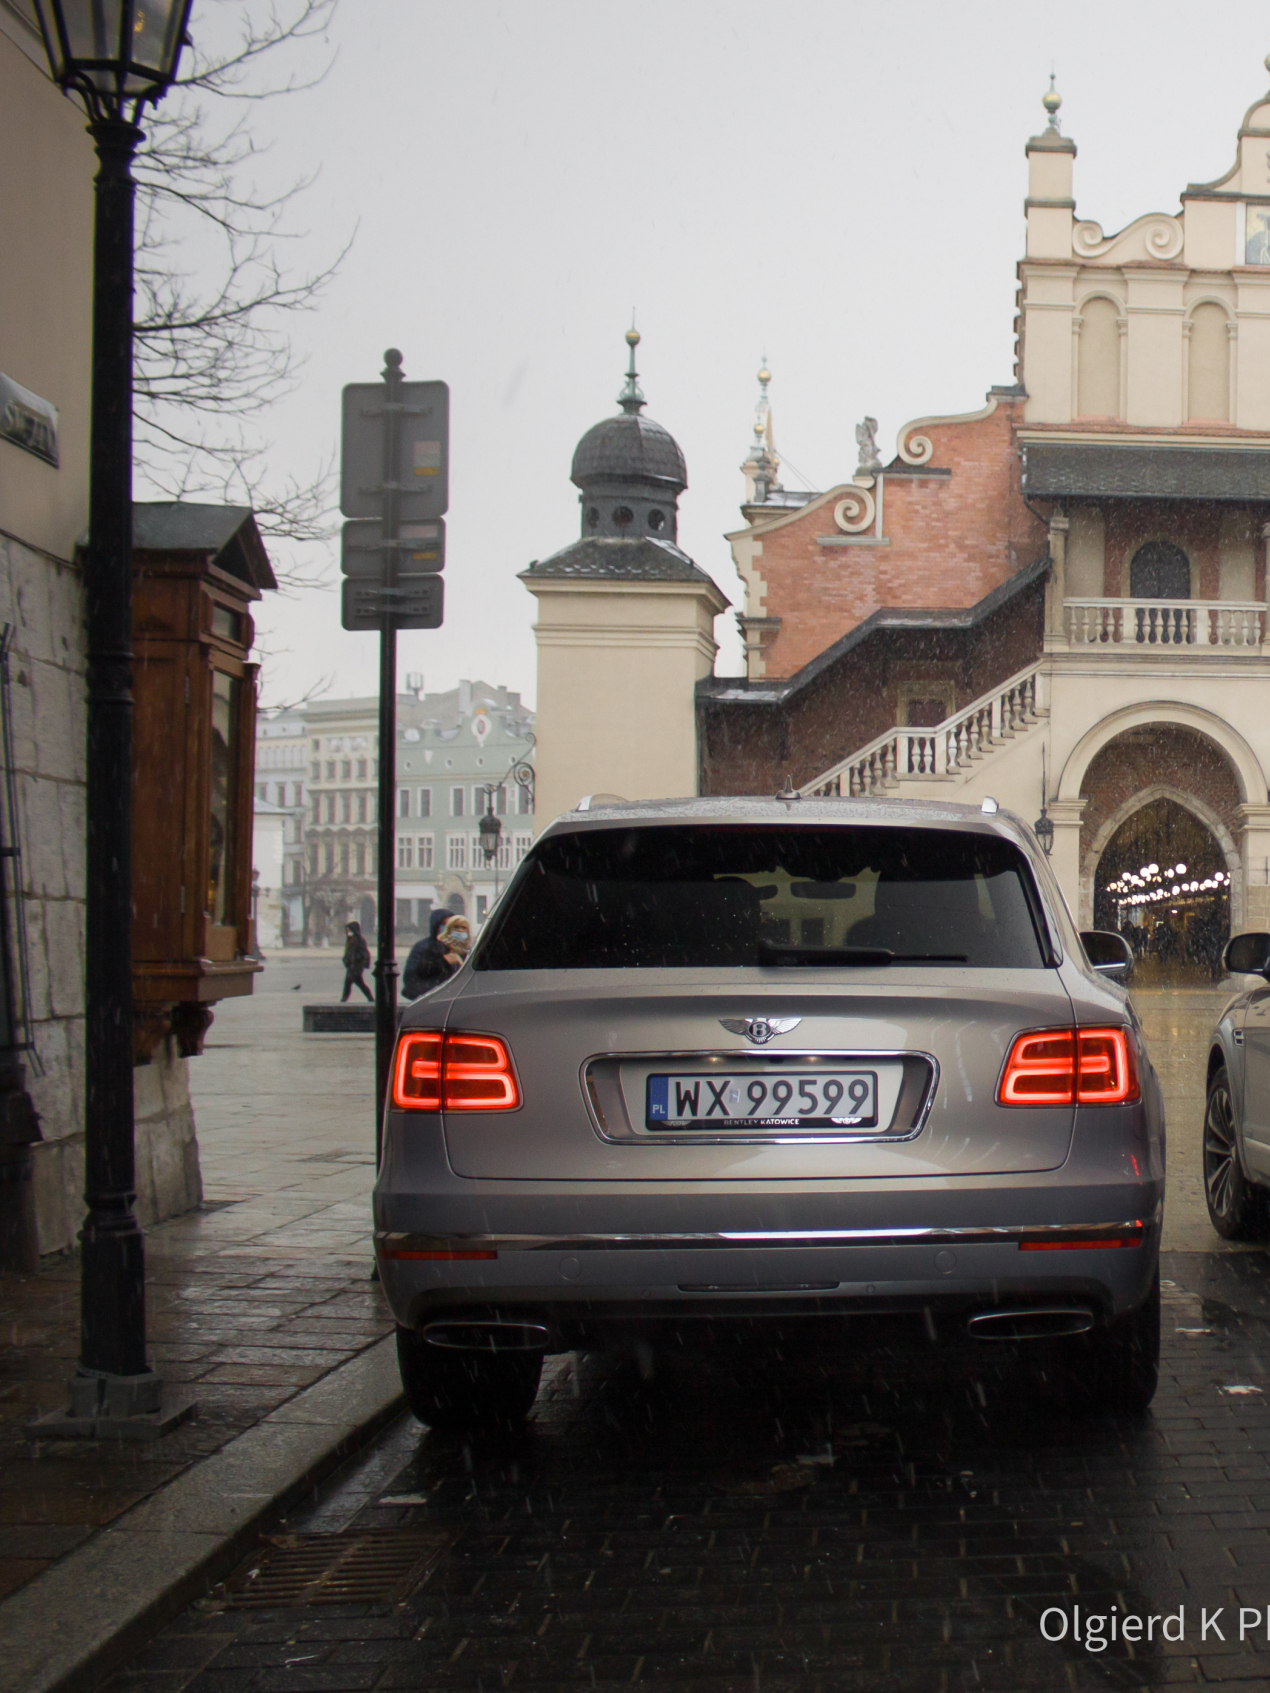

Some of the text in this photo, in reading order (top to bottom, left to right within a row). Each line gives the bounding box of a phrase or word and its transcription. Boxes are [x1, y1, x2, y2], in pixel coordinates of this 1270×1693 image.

[652, 1079, 870, 1117] PL WX 99599
[760, 1118, 800, 1126] KATOWICE
